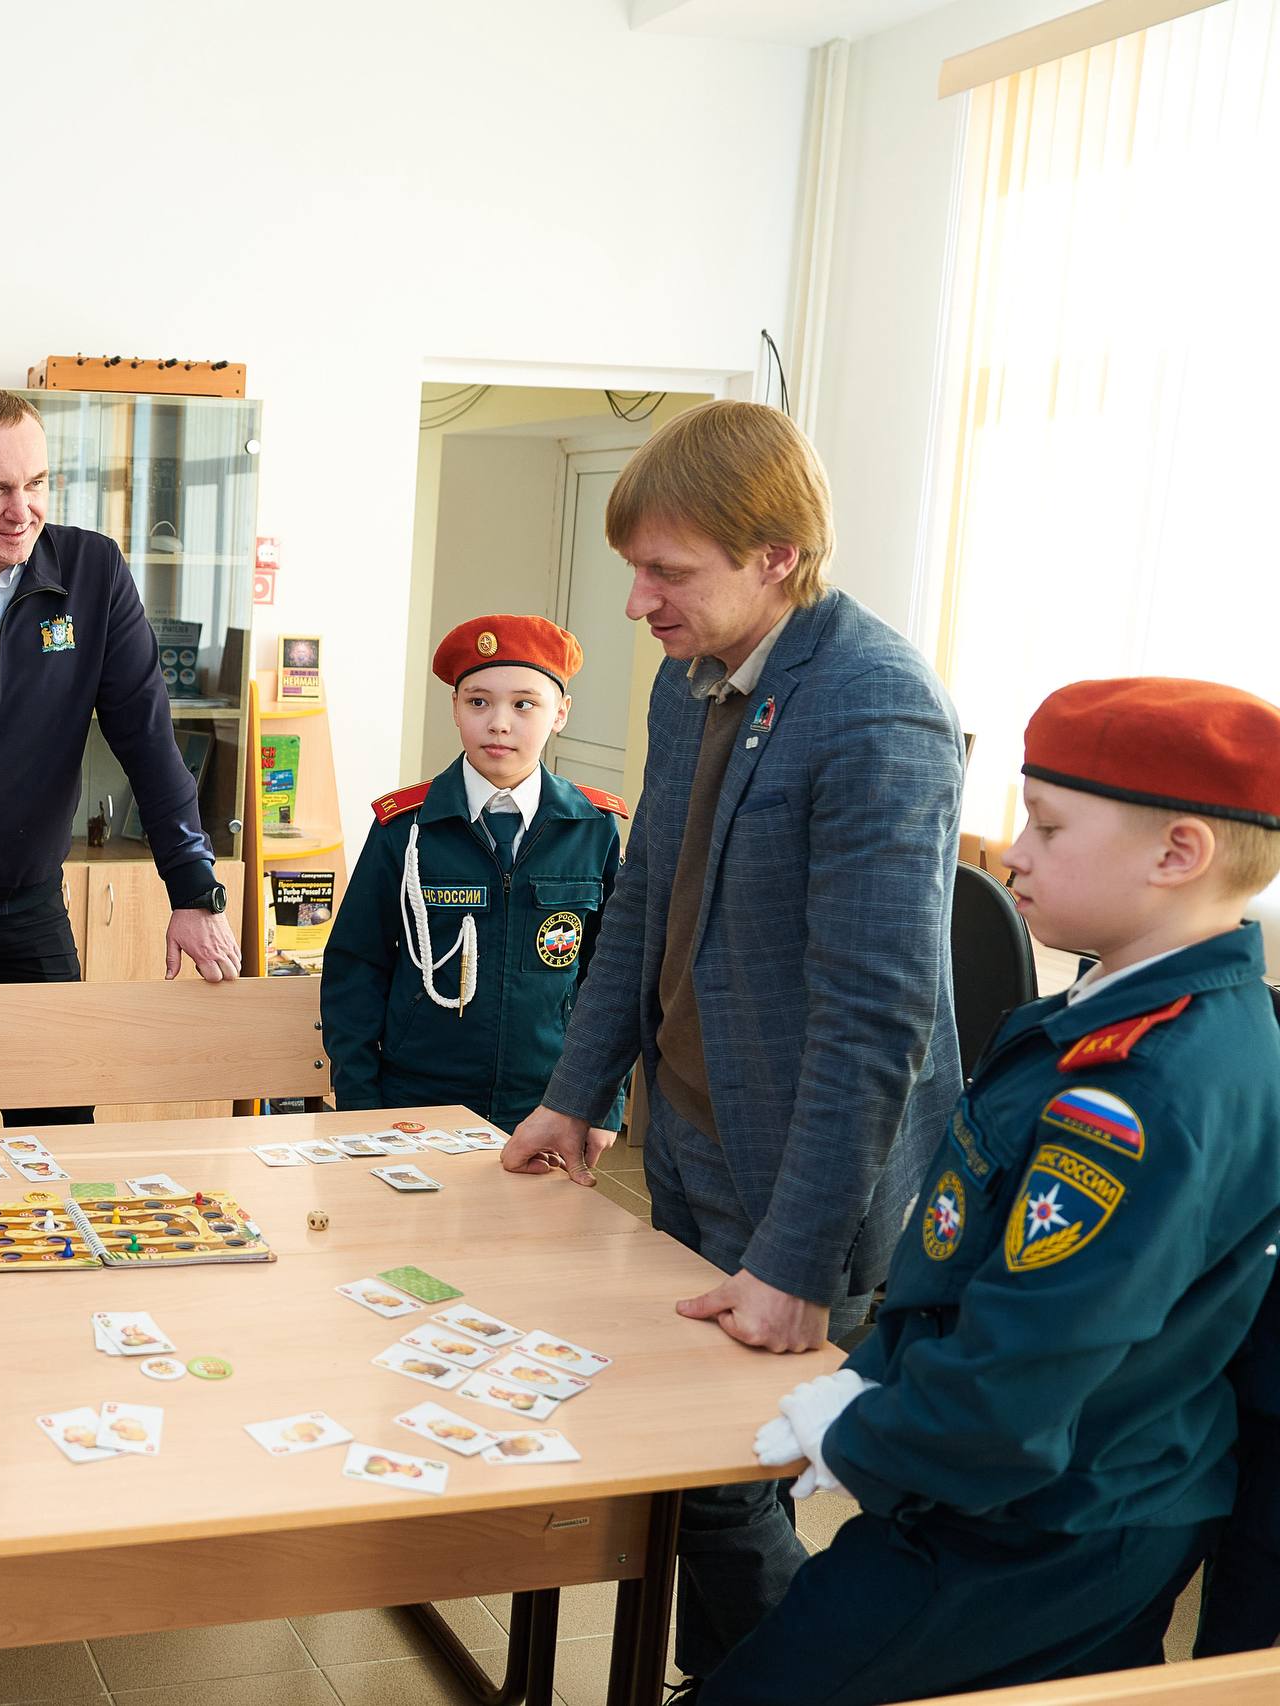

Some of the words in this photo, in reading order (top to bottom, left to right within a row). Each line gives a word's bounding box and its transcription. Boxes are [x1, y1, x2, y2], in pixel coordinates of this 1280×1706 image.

[321, 888, 332, 896] 7.0
[422, 889, 436, 903] ЧС
[437, 889, 481, 904] РОССИИ
[283, 895, 303, 905] Delphi
[541, 917, 556, 933] МЧС
[558, 914, 581, 932] РОССИИ
[1057, 1153, 1118, 1200] РОССИИ
